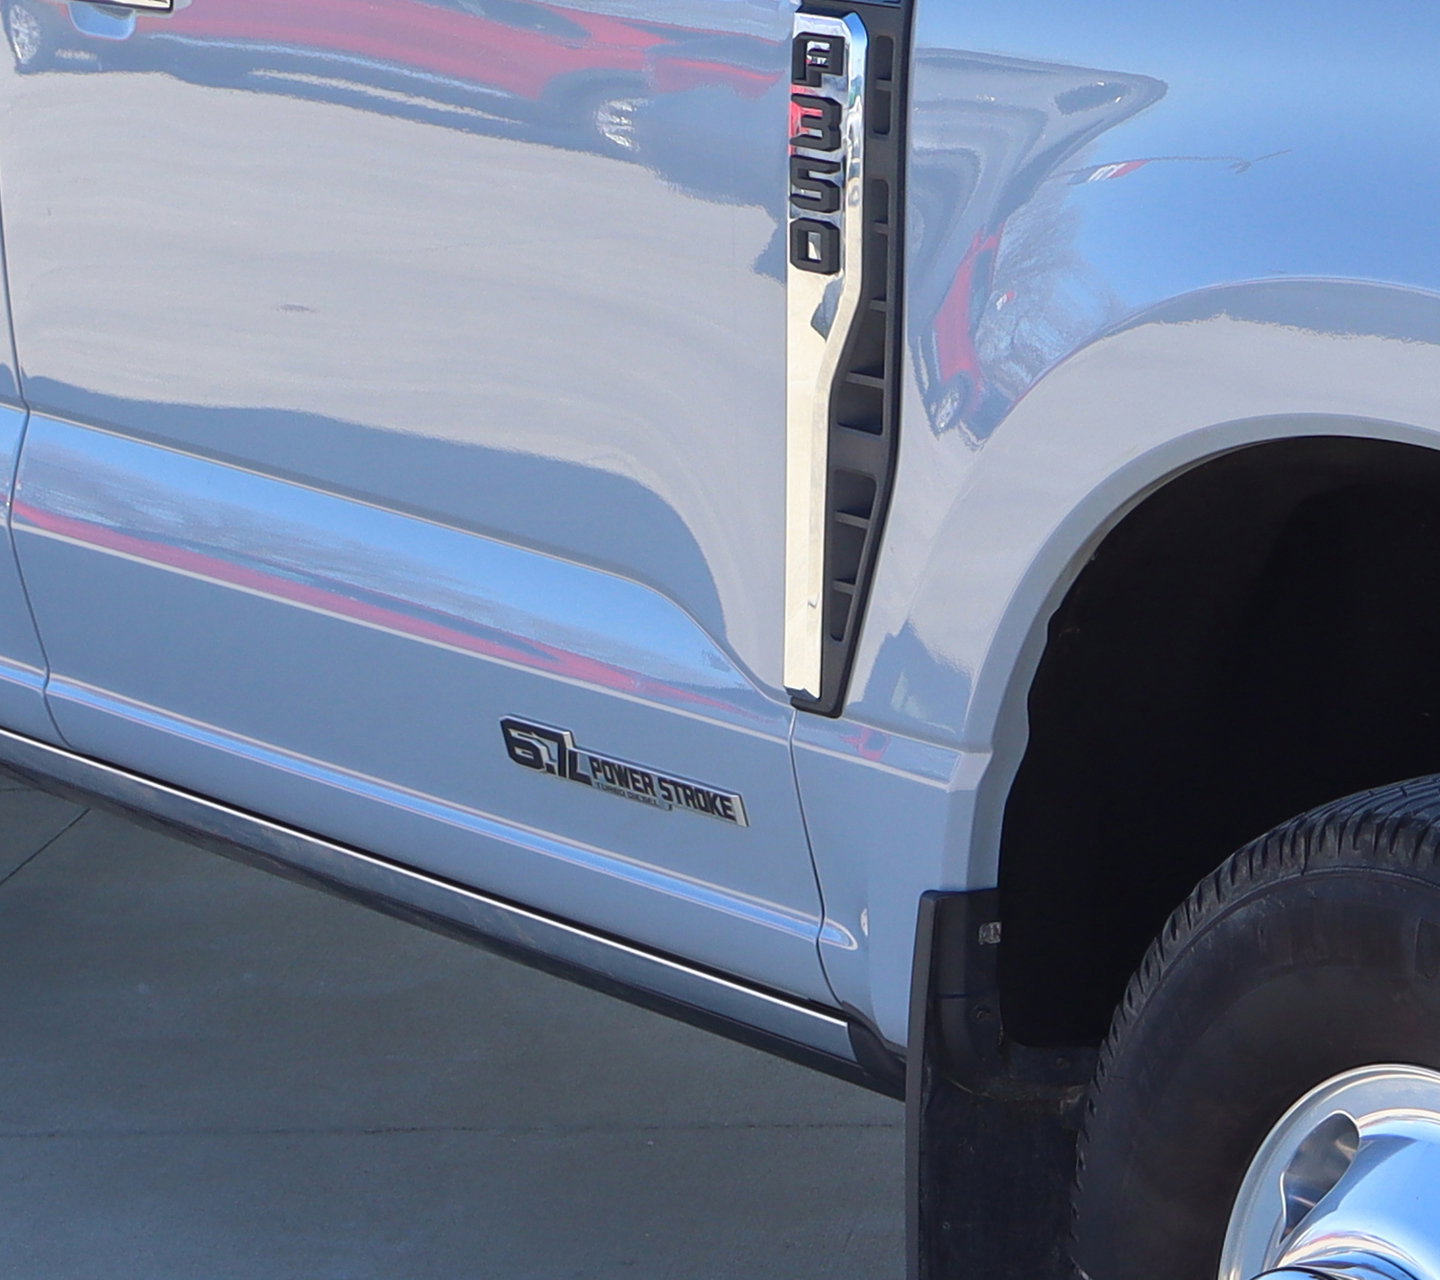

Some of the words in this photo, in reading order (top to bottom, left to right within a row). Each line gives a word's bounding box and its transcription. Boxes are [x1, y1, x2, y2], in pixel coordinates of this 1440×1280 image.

[789, 32, 847, 276] F350
[588, 755, 655, 798] POWER
[658, 776, 738, 821] STROKE
